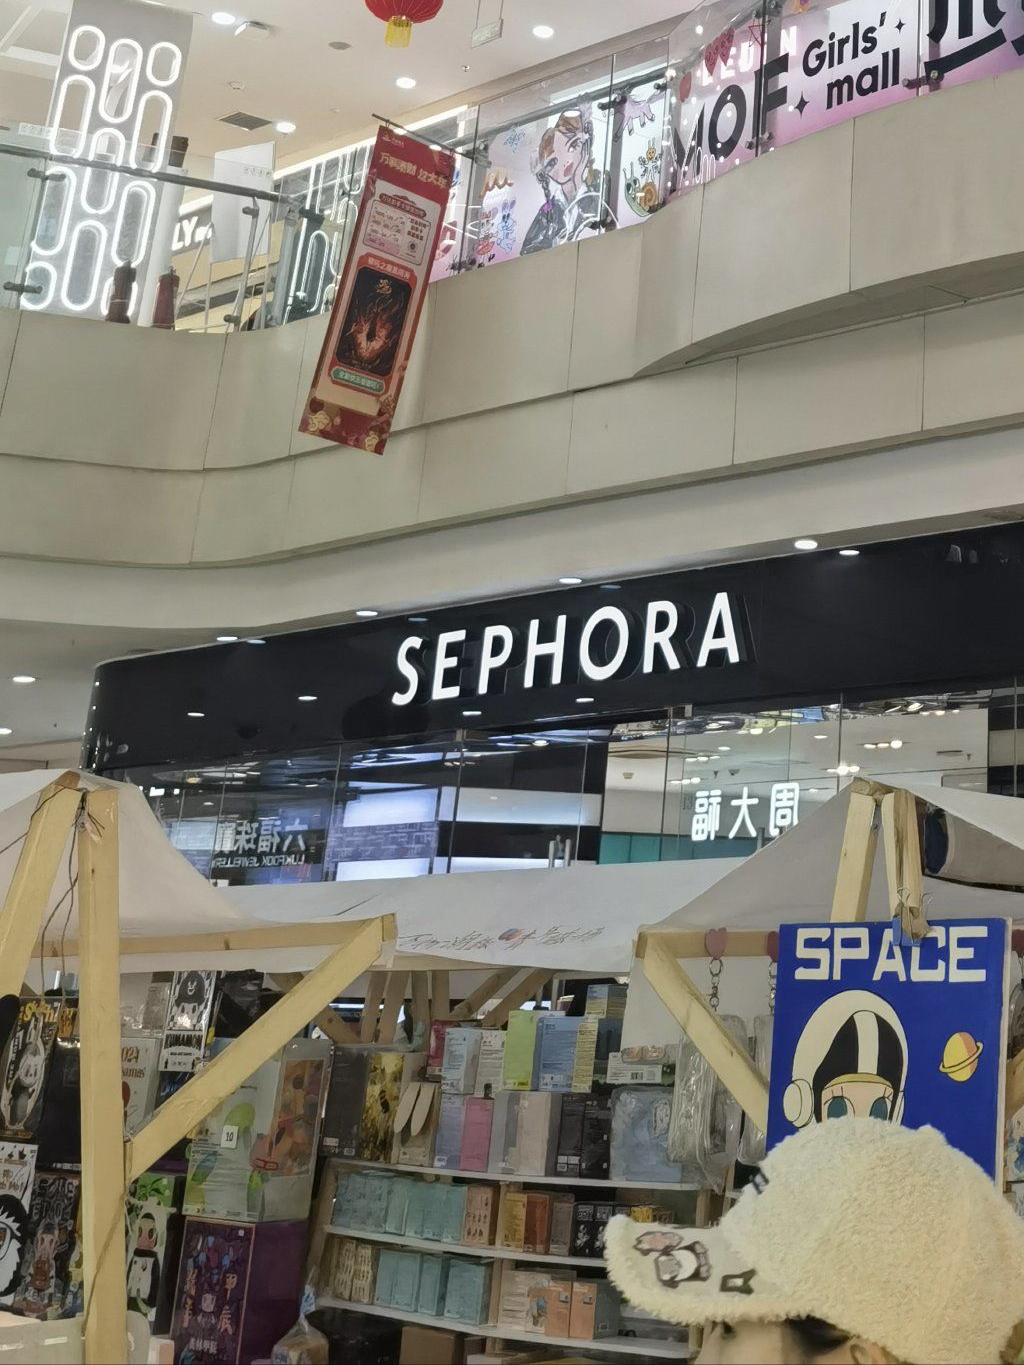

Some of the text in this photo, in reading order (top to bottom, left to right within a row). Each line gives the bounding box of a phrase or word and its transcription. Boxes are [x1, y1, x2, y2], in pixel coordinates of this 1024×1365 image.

[803, 11, 887, 77] Girls'
[826, 47, 900, 110] mall
[391, 591, 739, 706] SEPHORA
[794, 925, 989, 983] SPACE
